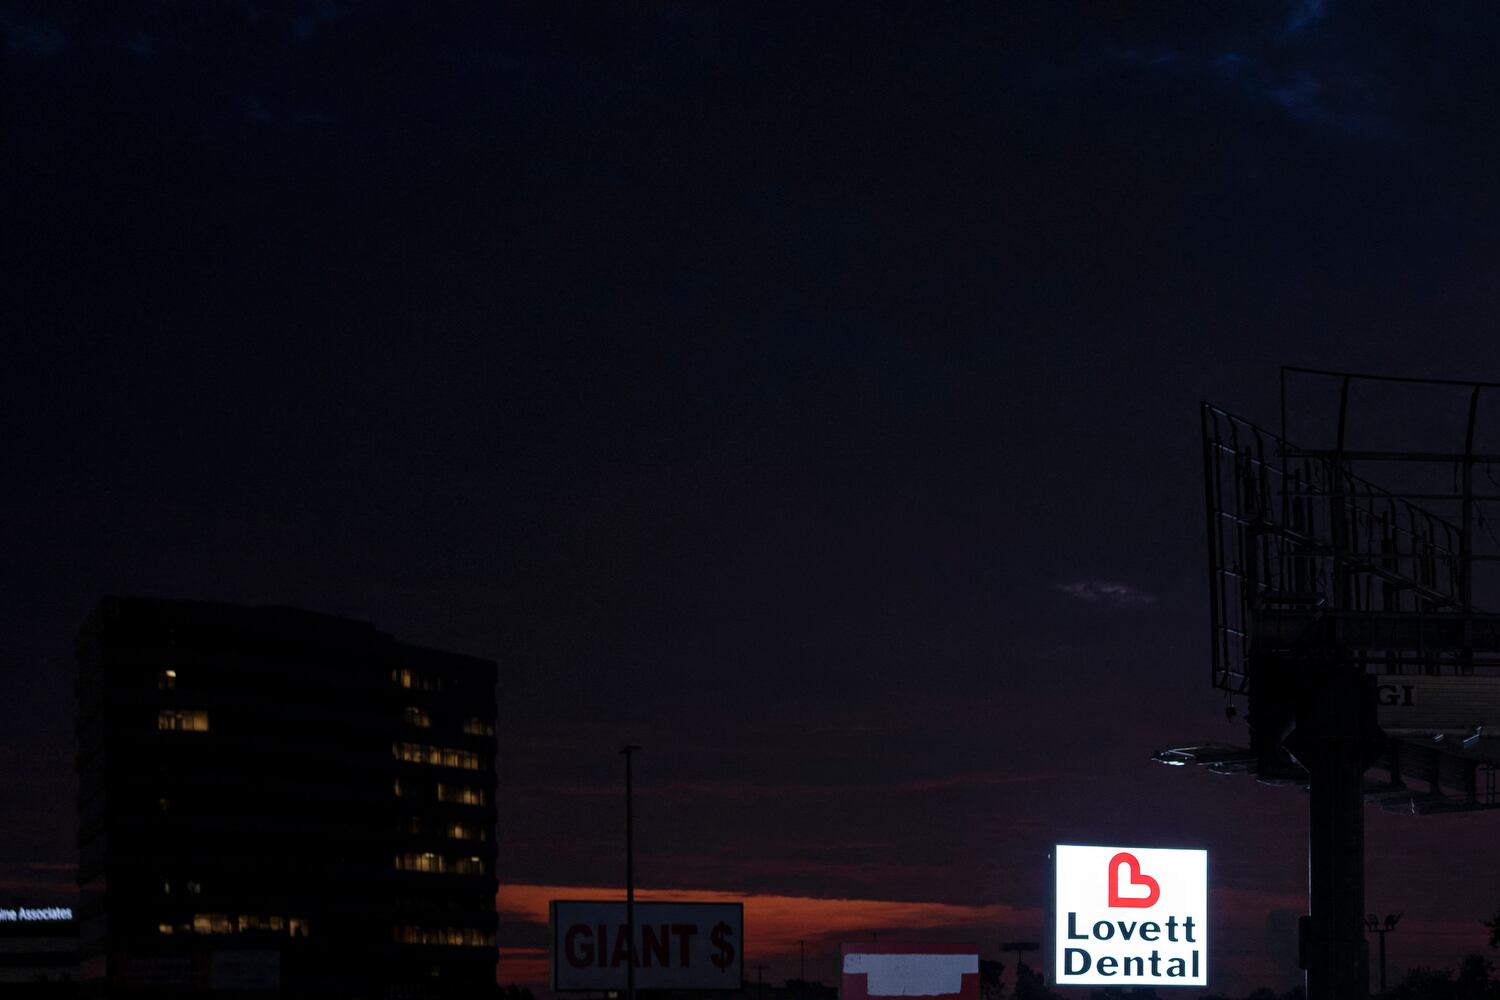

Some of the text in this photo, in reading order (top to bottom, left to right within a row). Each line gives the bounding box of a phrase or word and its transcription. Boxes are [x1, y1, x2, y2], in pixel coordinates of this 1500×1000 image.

[18, 906, 73, 921] Associates
[1068, 912, 1196, 943] Lovett
[565, 921, 735, 973] GIANT $
[1064, 948, 1199, 978] Dental
